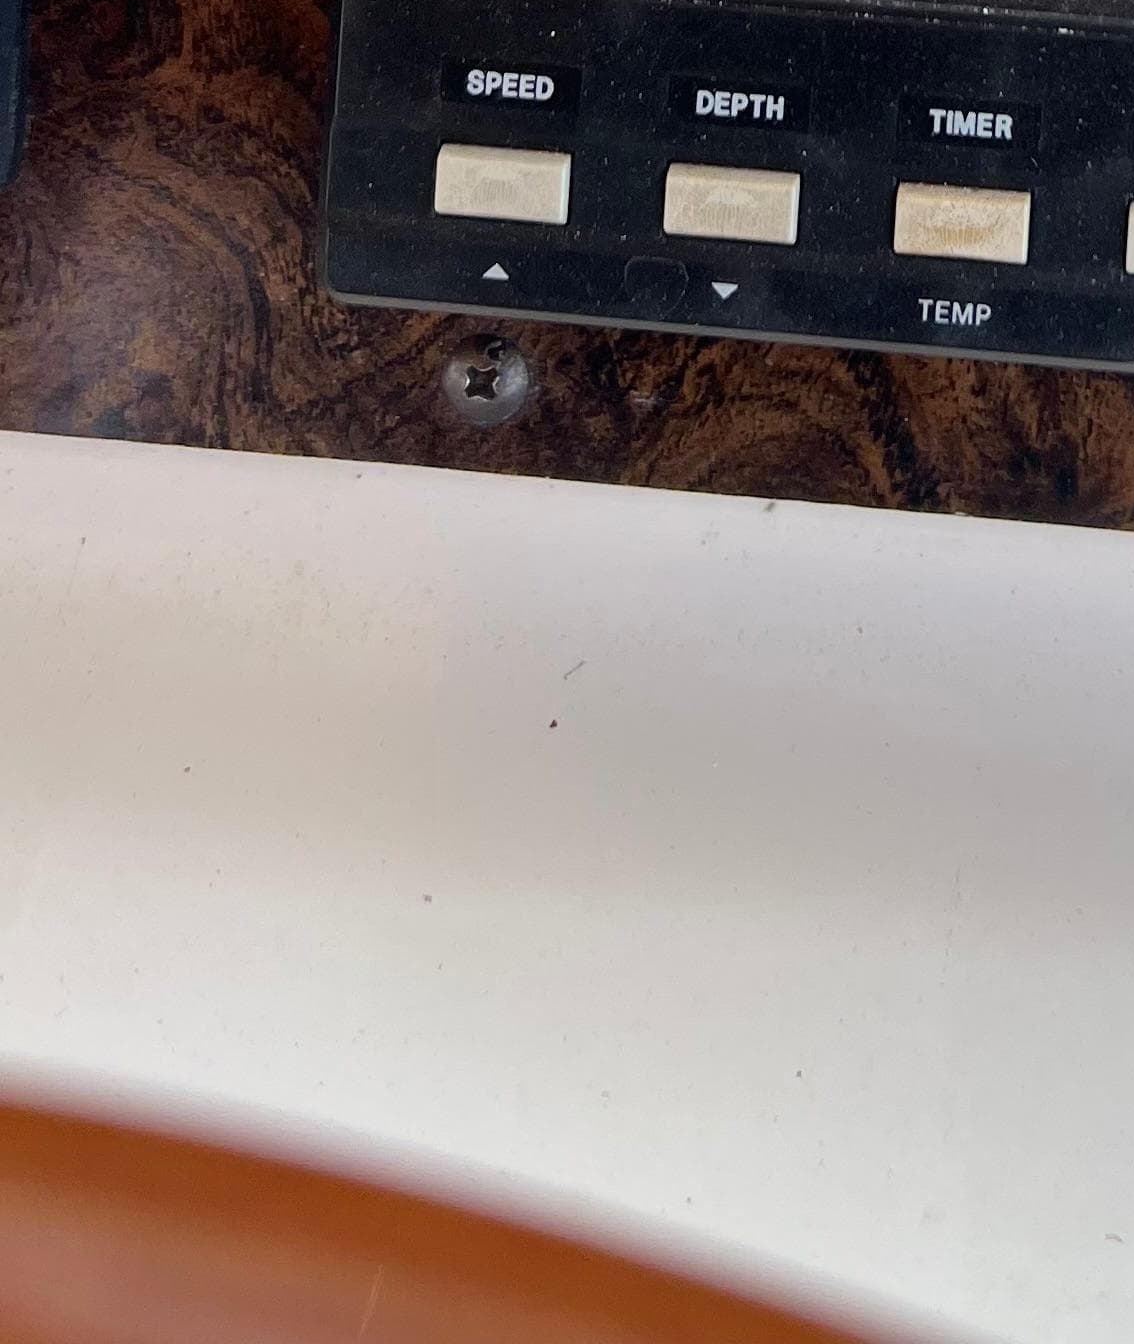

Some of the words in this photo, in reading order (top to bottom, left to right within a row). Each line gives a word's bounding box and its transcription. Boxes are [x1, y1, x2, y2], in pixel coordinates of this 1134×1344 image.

[467, 69, 555, 100] SPEED
[695, 89, 785, 121] DEPTH
[929, 108, 1013, 140] TIMER
[918, 298, 992, 326] TEMP
